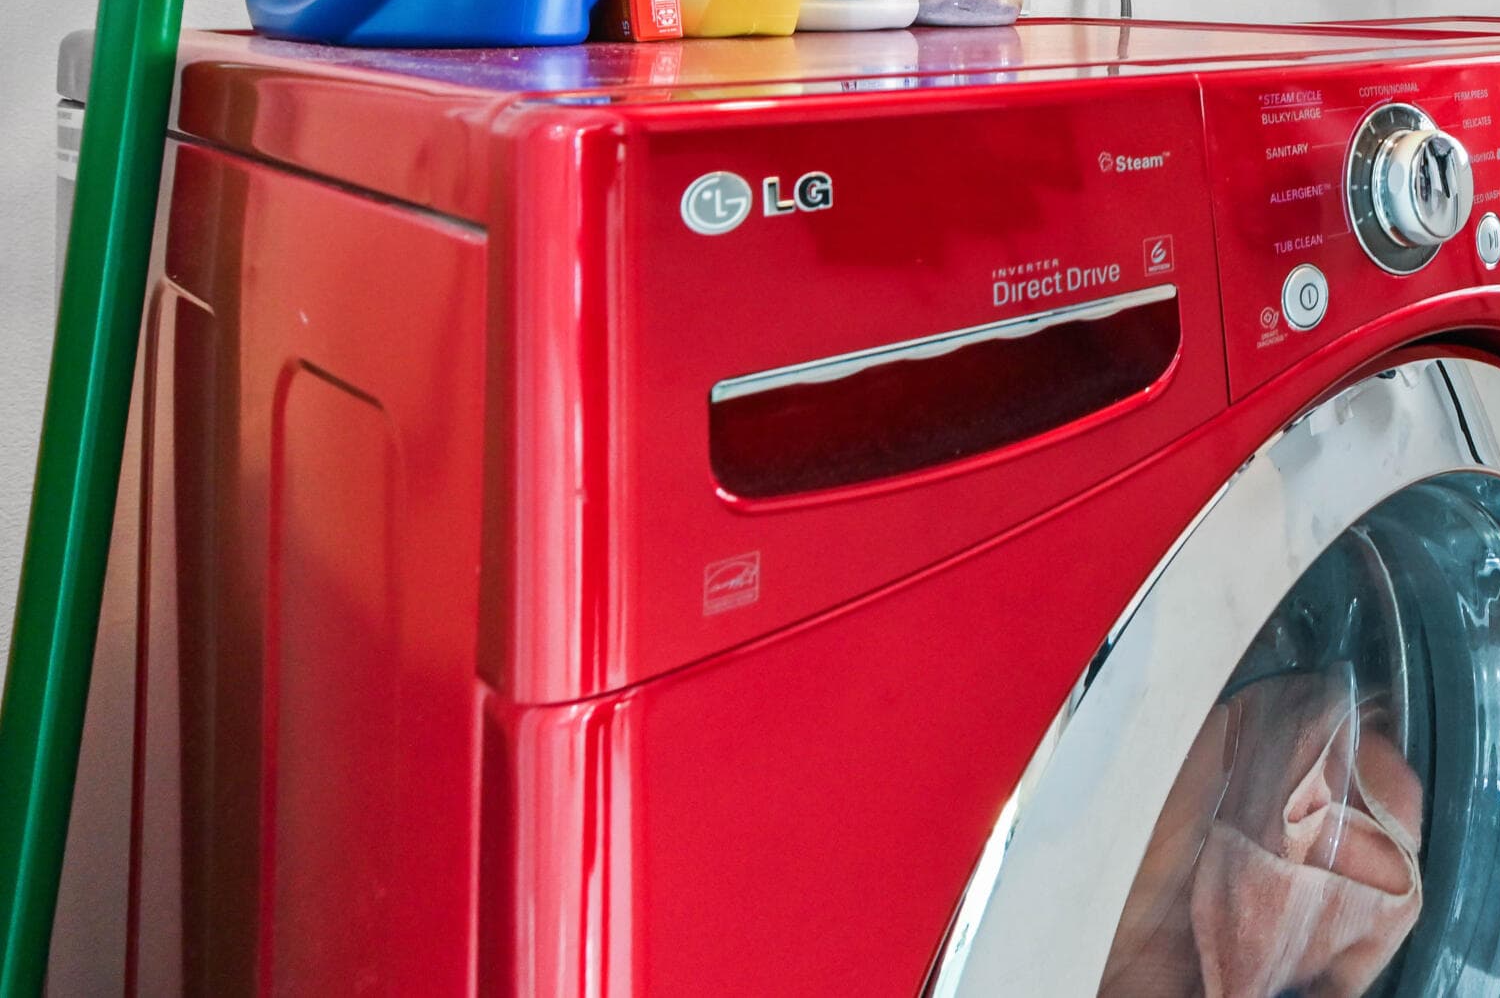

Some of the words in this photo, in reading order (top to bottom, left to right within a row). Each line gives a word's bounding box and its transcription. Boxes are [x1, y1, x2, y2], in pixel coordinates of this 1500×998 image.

[1296, 90, 1322, 103] CYCLE
[1261, 108, 1321, 125] BULKY/LARGE
[1266, 143, 1308, 159] SANITARY
[762, 171, 834, 217] LG
[1274, 240, 1292, 254] TUB
[1294, 234, 1323, 251] CLEAN
[992, 258, 1060, 279] INVERTER
[993, 271, 1062, 306] Direct
[1066, 263, 1120, 292] Drive
